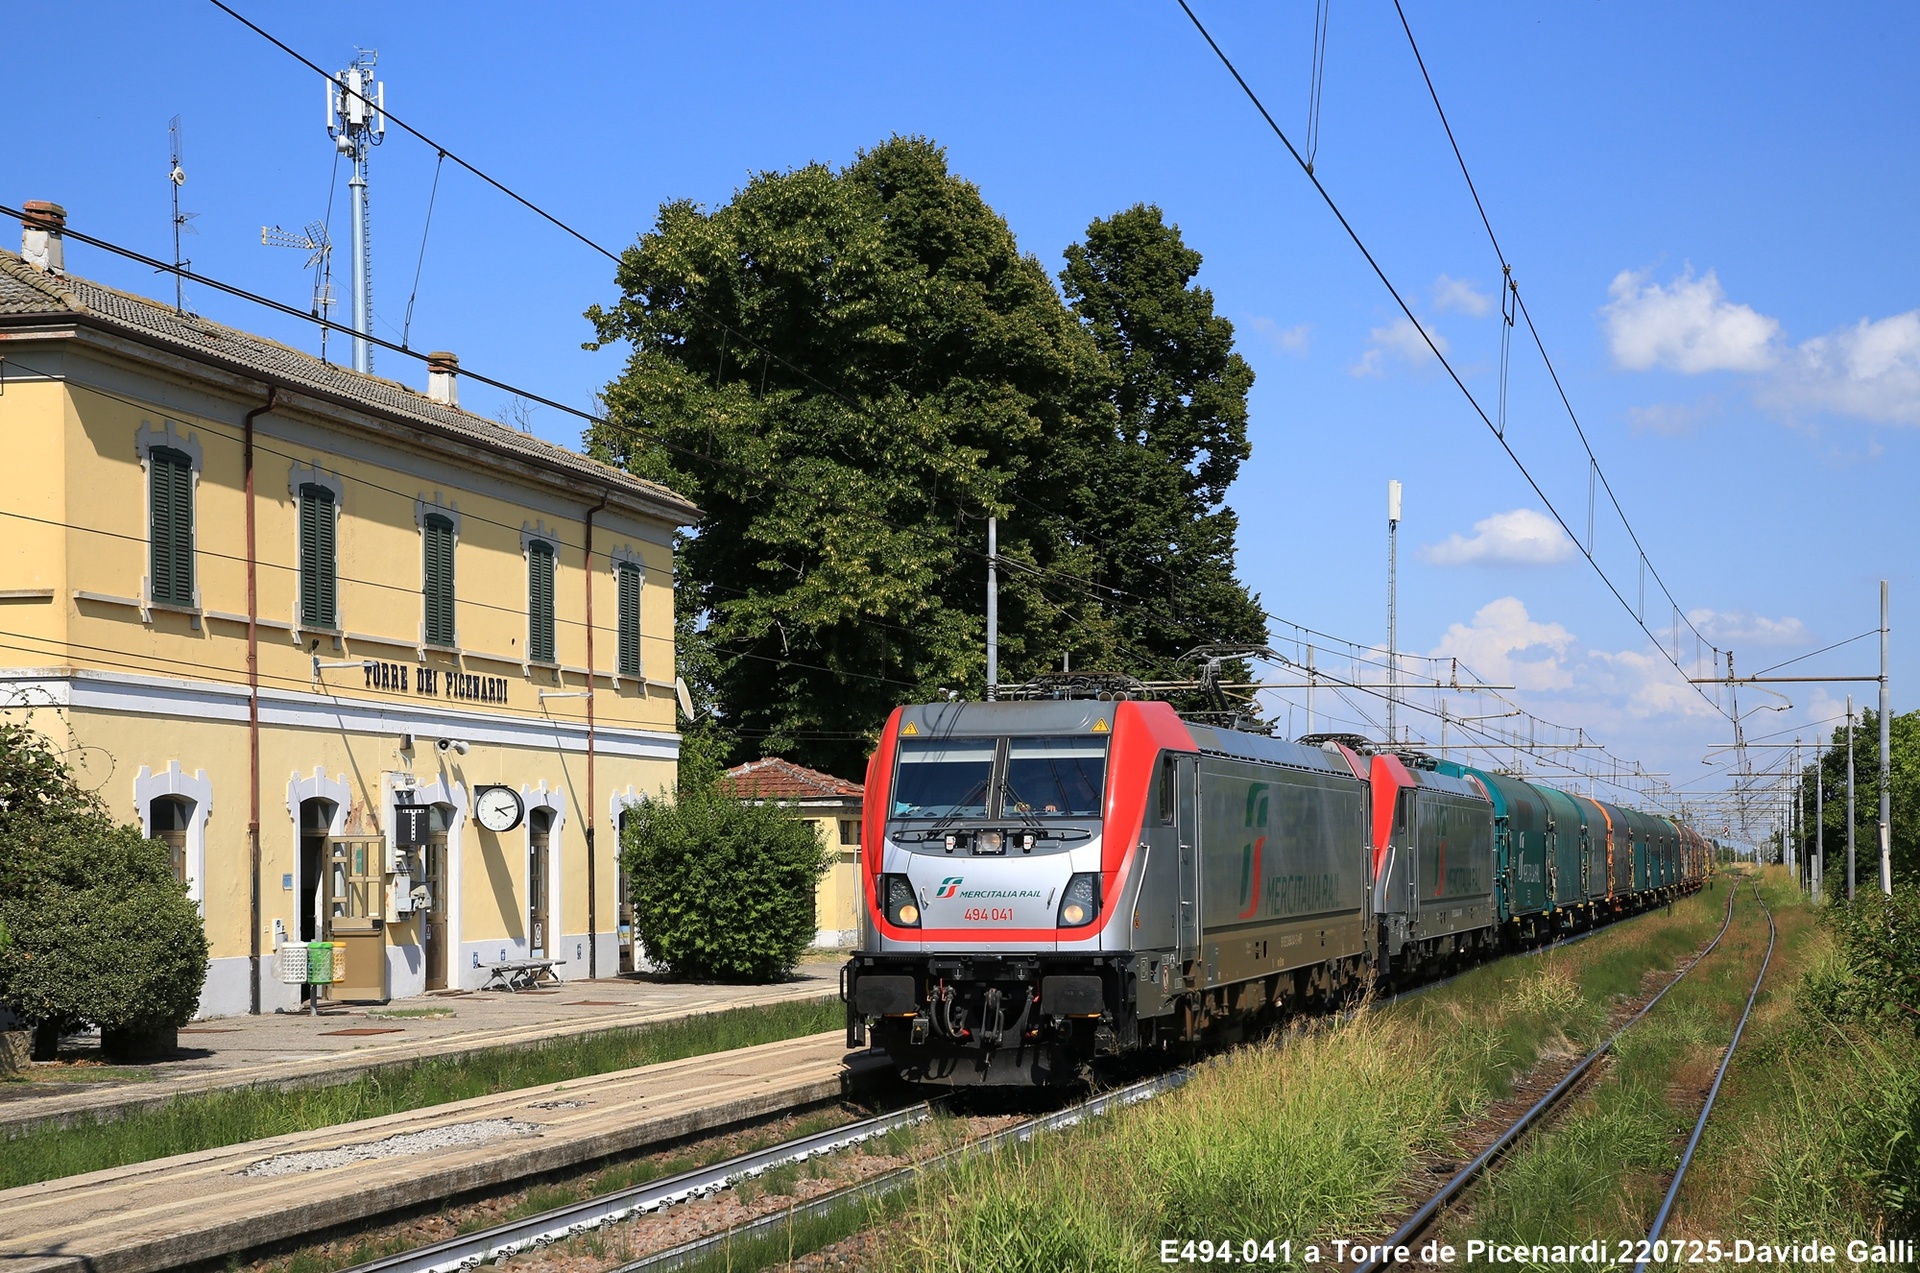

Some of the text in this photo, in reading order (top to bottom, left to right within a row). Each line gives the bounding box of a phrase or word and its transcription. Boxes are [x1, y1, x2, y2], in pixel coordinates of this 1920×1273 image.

[364, 660, 508, 704] TORRE DEI PICENARDI
[959, 890, 1042, 899] MERCITALIA RAIL
[1266, 874, 1321, 916] MERCITALIA
[964, 908, 1014, 921] 494 041
